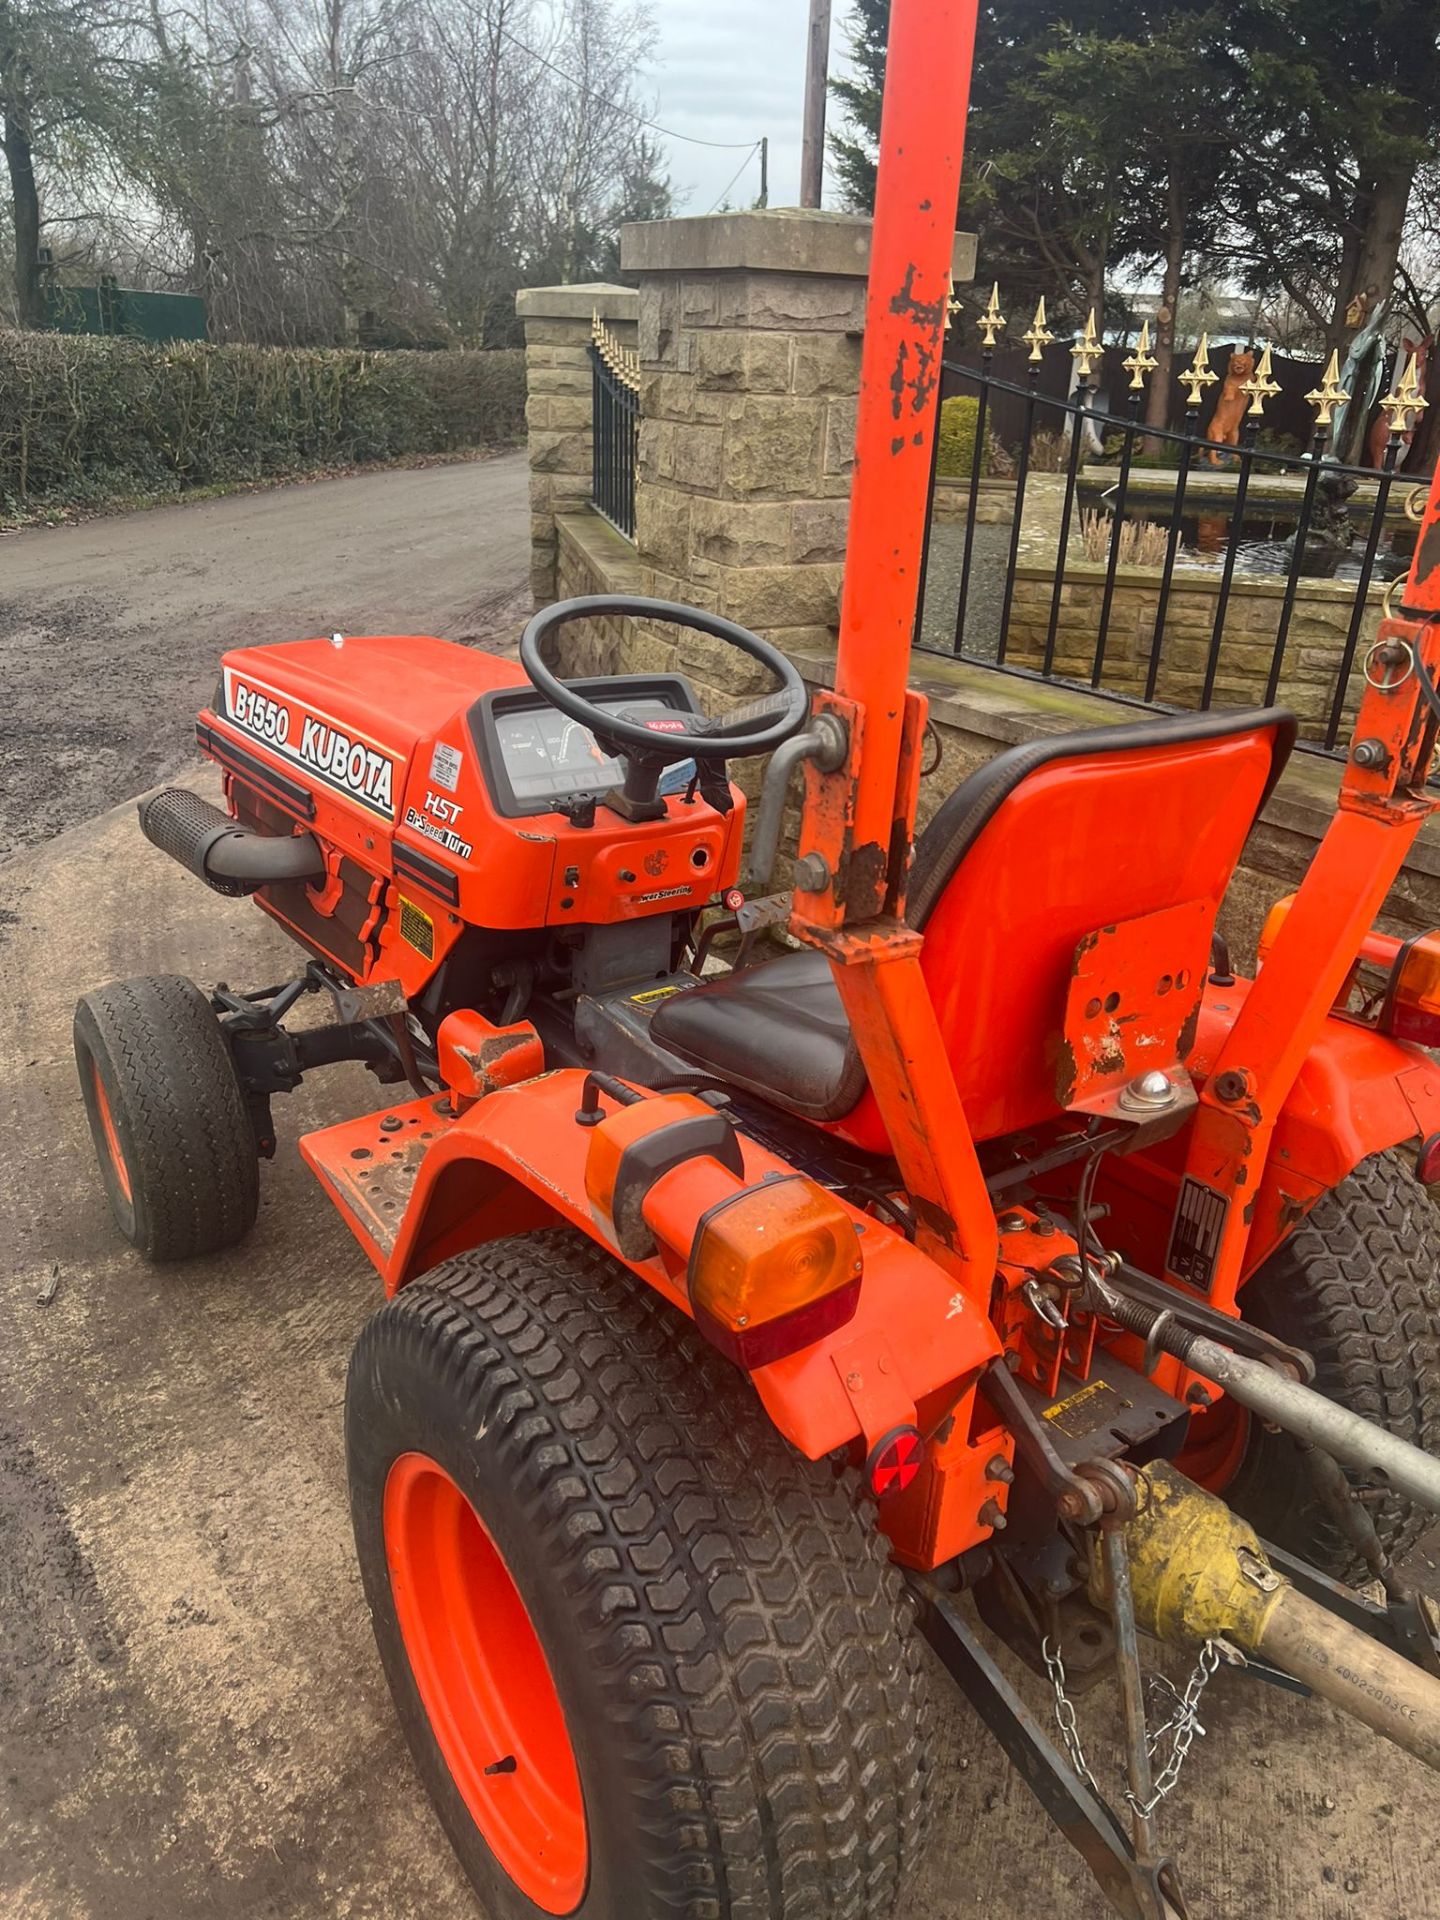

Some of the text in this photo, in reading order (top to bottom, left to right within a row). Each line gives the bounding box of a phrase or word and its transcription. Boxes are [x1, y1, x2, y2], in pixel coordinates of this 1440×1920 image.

[234, 682, 291, 745] B1550
[300, 715, 394, 812] KUBOTA
[423, 790, 464, 825] HST
